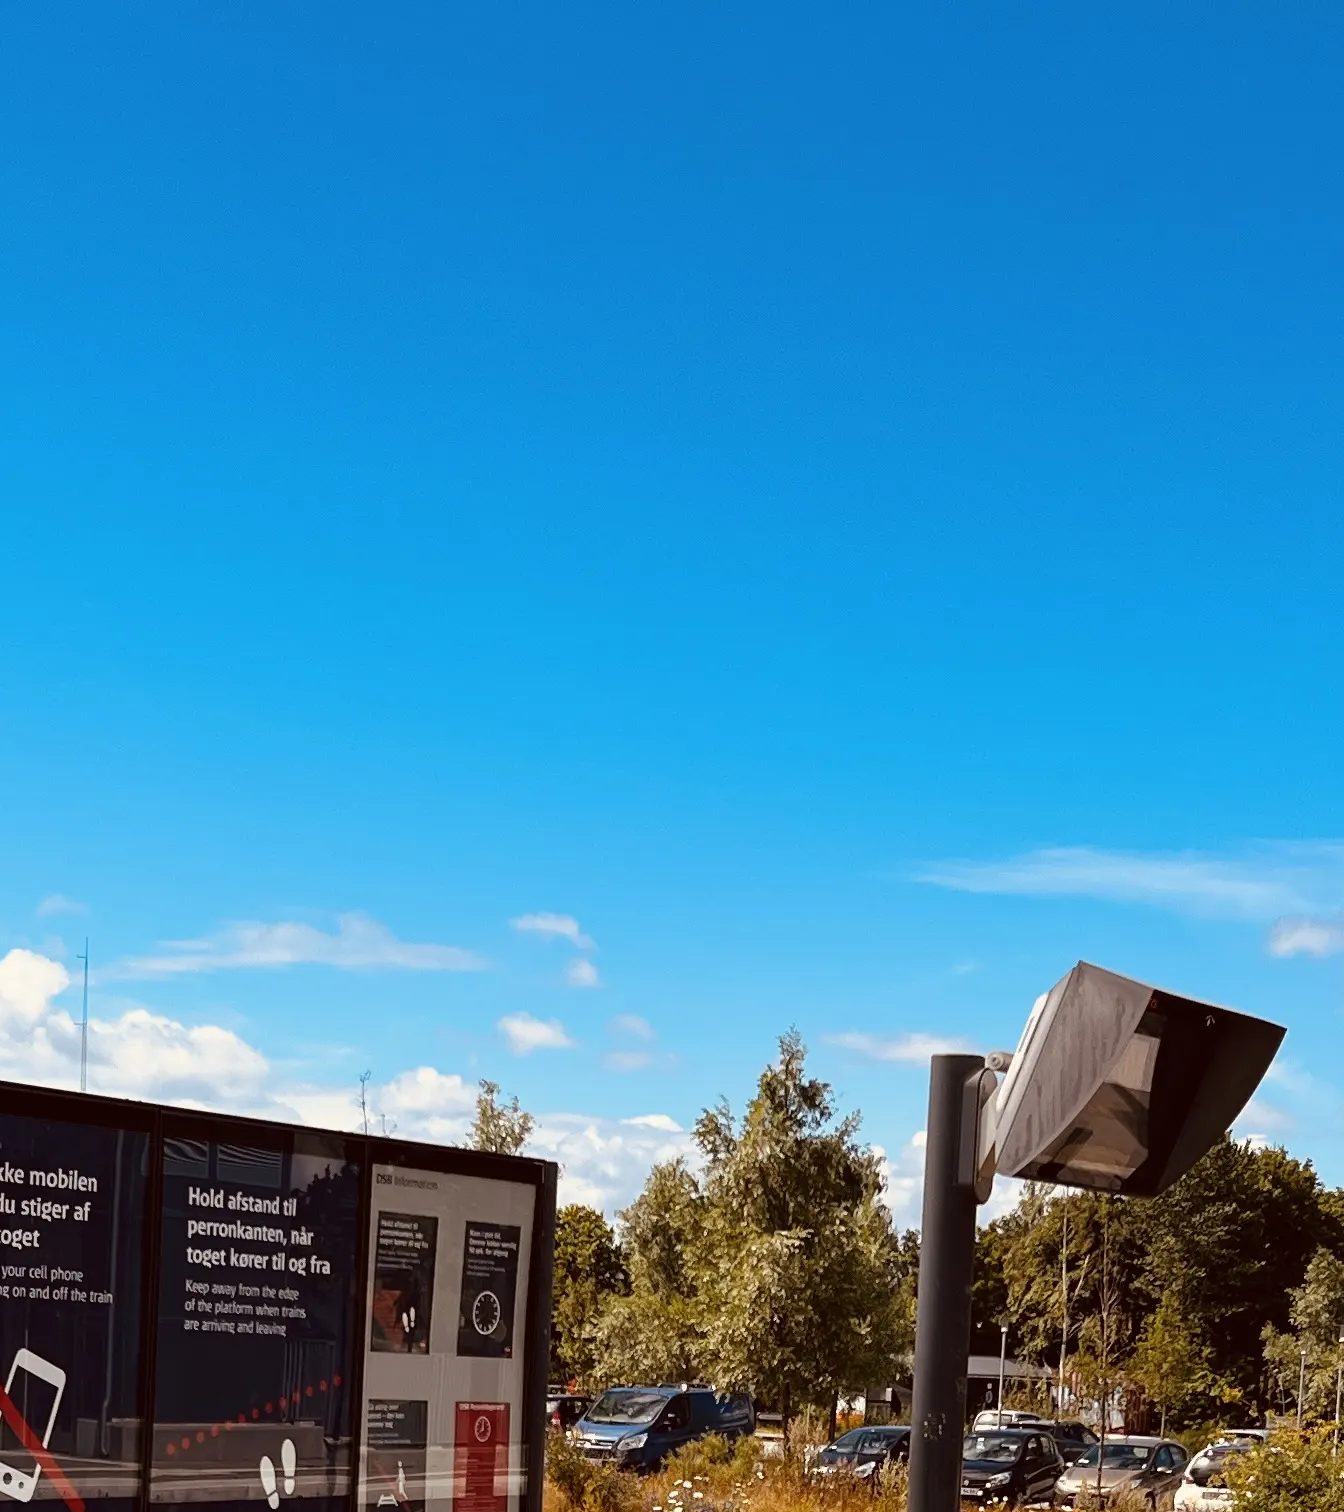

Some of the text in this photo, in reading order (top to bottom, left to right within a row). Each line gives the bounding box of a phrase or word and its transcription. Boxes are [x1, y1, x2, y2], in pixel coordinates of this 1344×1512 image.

[29, 1168, 98, 1192] mobilen
[20, 1197, 69, 1222] stiger
[73, 1202, 91, 1221] af
[188, 1186, 297, 1217] Hold afstand til
[187, 1220, 314, 1246] perronkanten, når
[186, 1247, 331, 1276] toget kører til og fra
[1, 1265, 26, 1279] your
[28, 1265, 48, 1280] cell
[50, 1266, 83, 1282] phone
[12, 1286, 26, 1297] on
[29, 1285, 49, 1300] and
[52, 1286, 68, 1301] off
[70, 1288, 87, 1302] the
[89, 1290, 113, 1304] train
[185, 1278, 299, 1301] Keep away from the edge
[184, 1298, 306, 1319] of the platform when trains
[183, 1319, 286, 1337] are arriving and leaving
